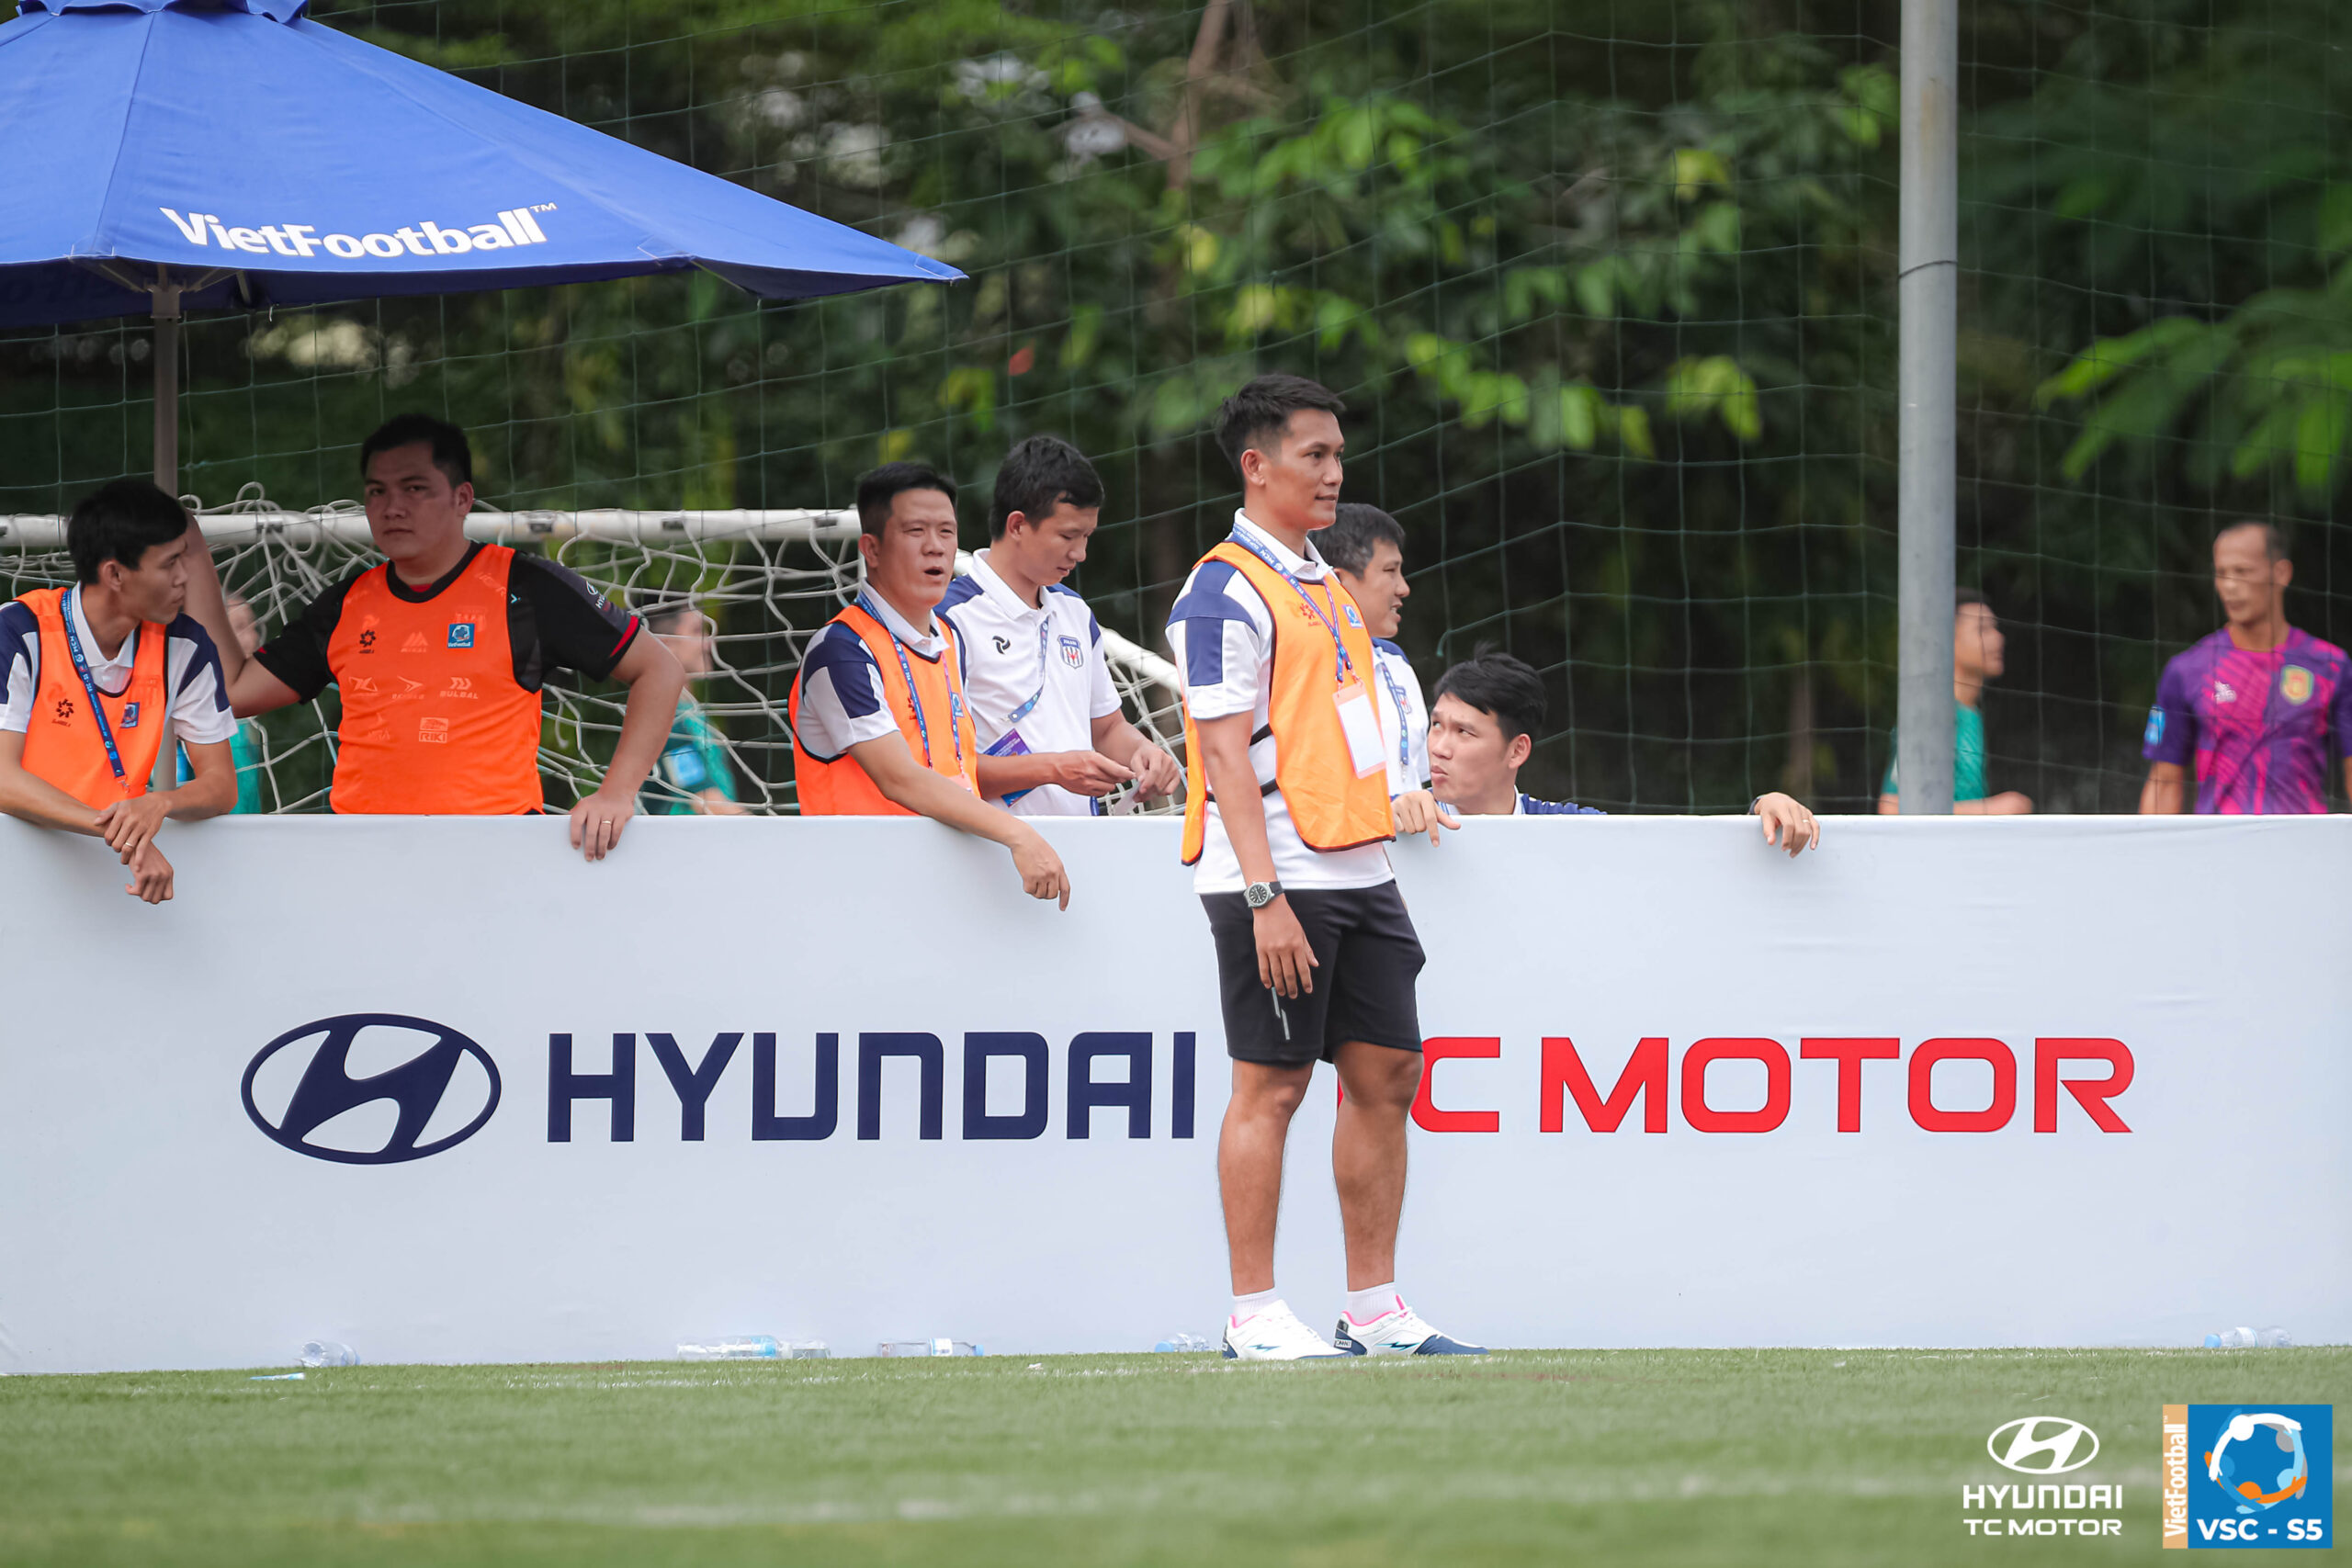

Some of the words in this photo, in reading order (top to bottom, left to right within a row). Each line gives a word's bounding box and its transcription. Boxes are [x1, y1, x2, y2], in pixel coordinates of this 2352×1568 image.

[420, 732, 447, 742] RIKI
[548, 1032, 1196, 1143] HYUNDAI
[1541, 1036, 2134, 1134] MOTOR
